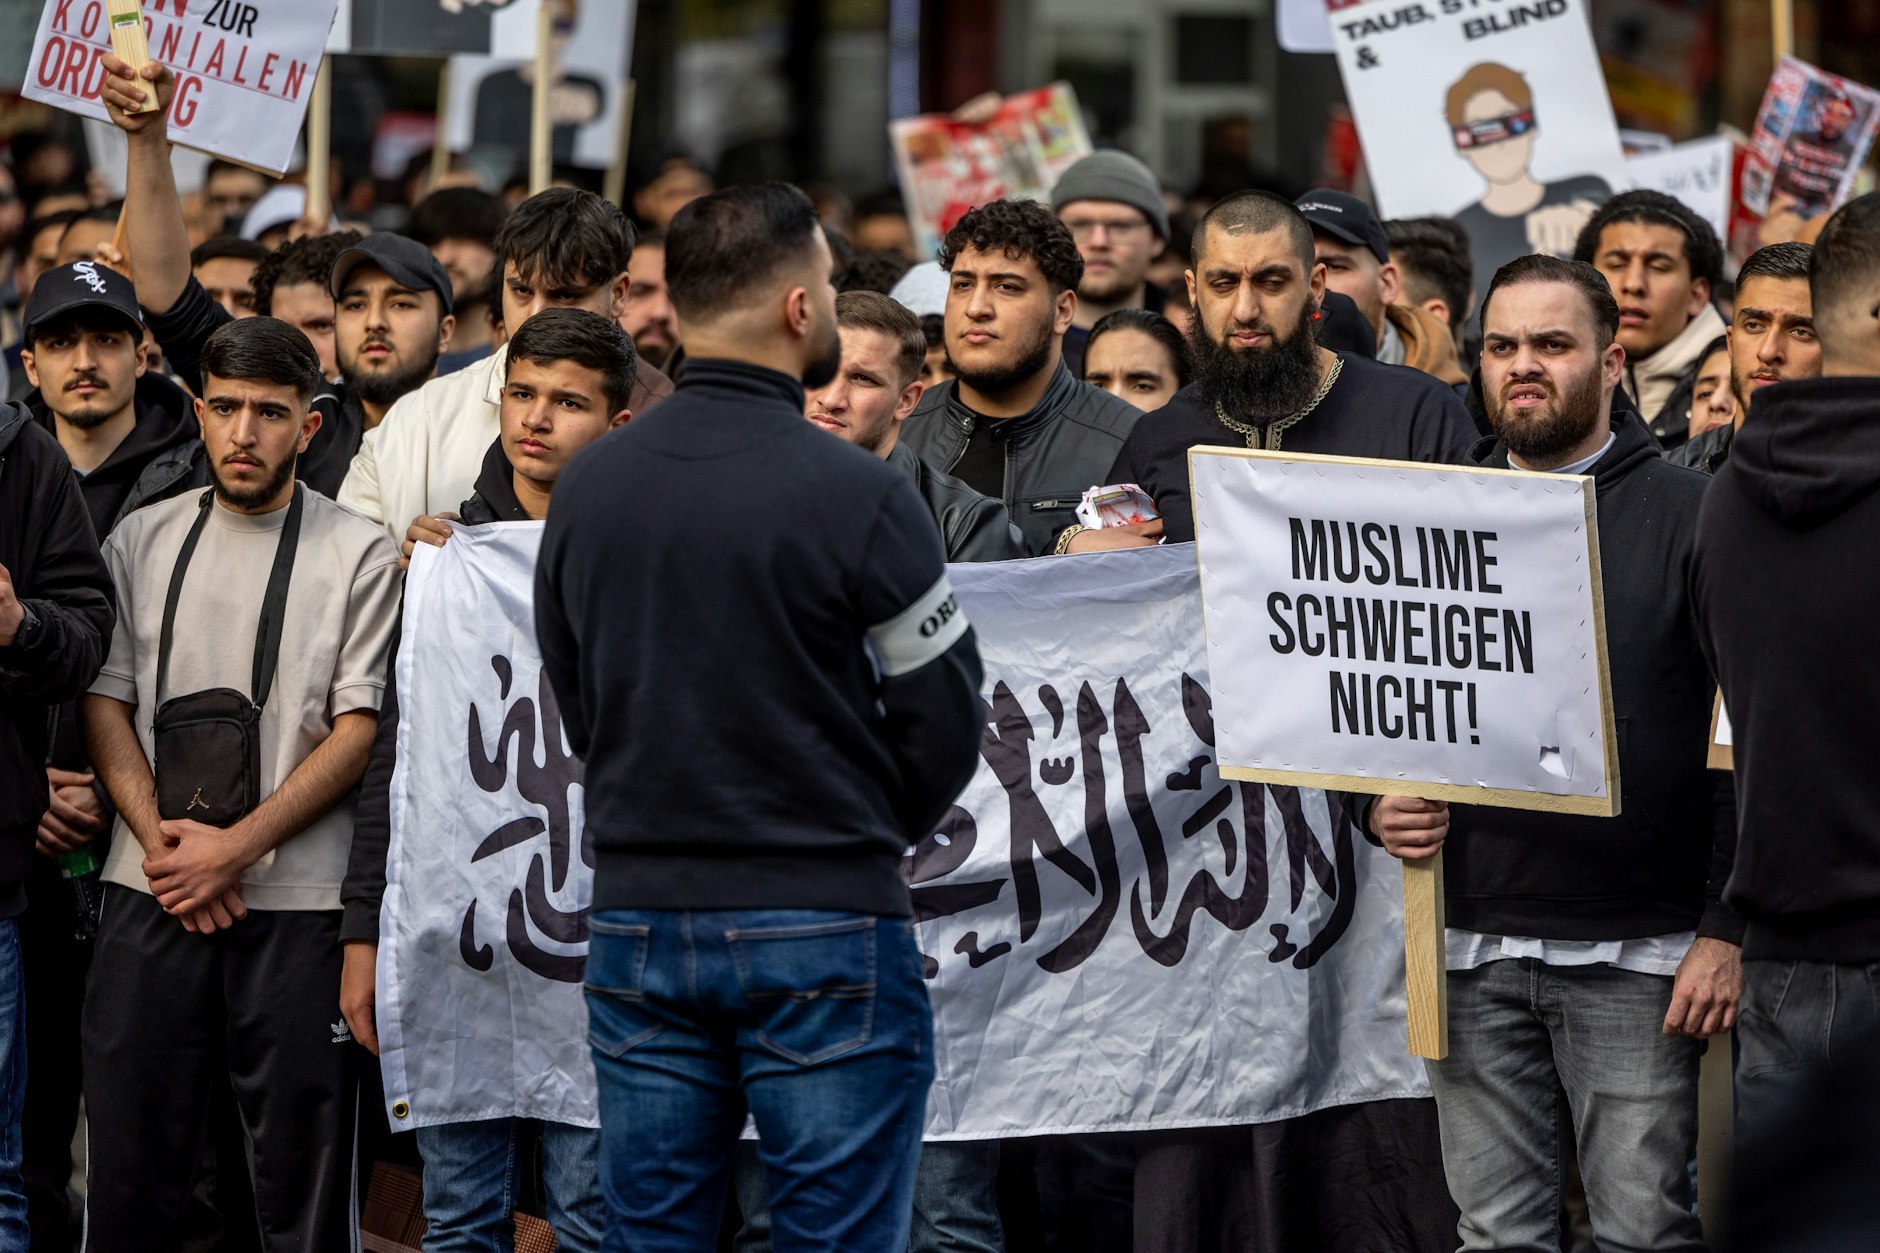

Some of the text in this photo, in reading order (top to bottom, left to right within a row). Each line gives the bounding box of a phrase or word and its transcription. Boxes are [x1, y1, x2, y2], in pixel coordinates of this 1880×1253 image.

[202, 0, 258, 38] ZUR
[1340, 4, 1435, 41] TAUB,
[1356, 46, 1381, 70] &
[1462, 0, 1568, 41] BLIND
[37, 37, 203, 127] ORDG
[1288, 517, 1502, 594] MUSLIME
[1266, 591, 1534, 674] SCHWEIGEN
[1329, 670, 1480, 745] NICHT!
